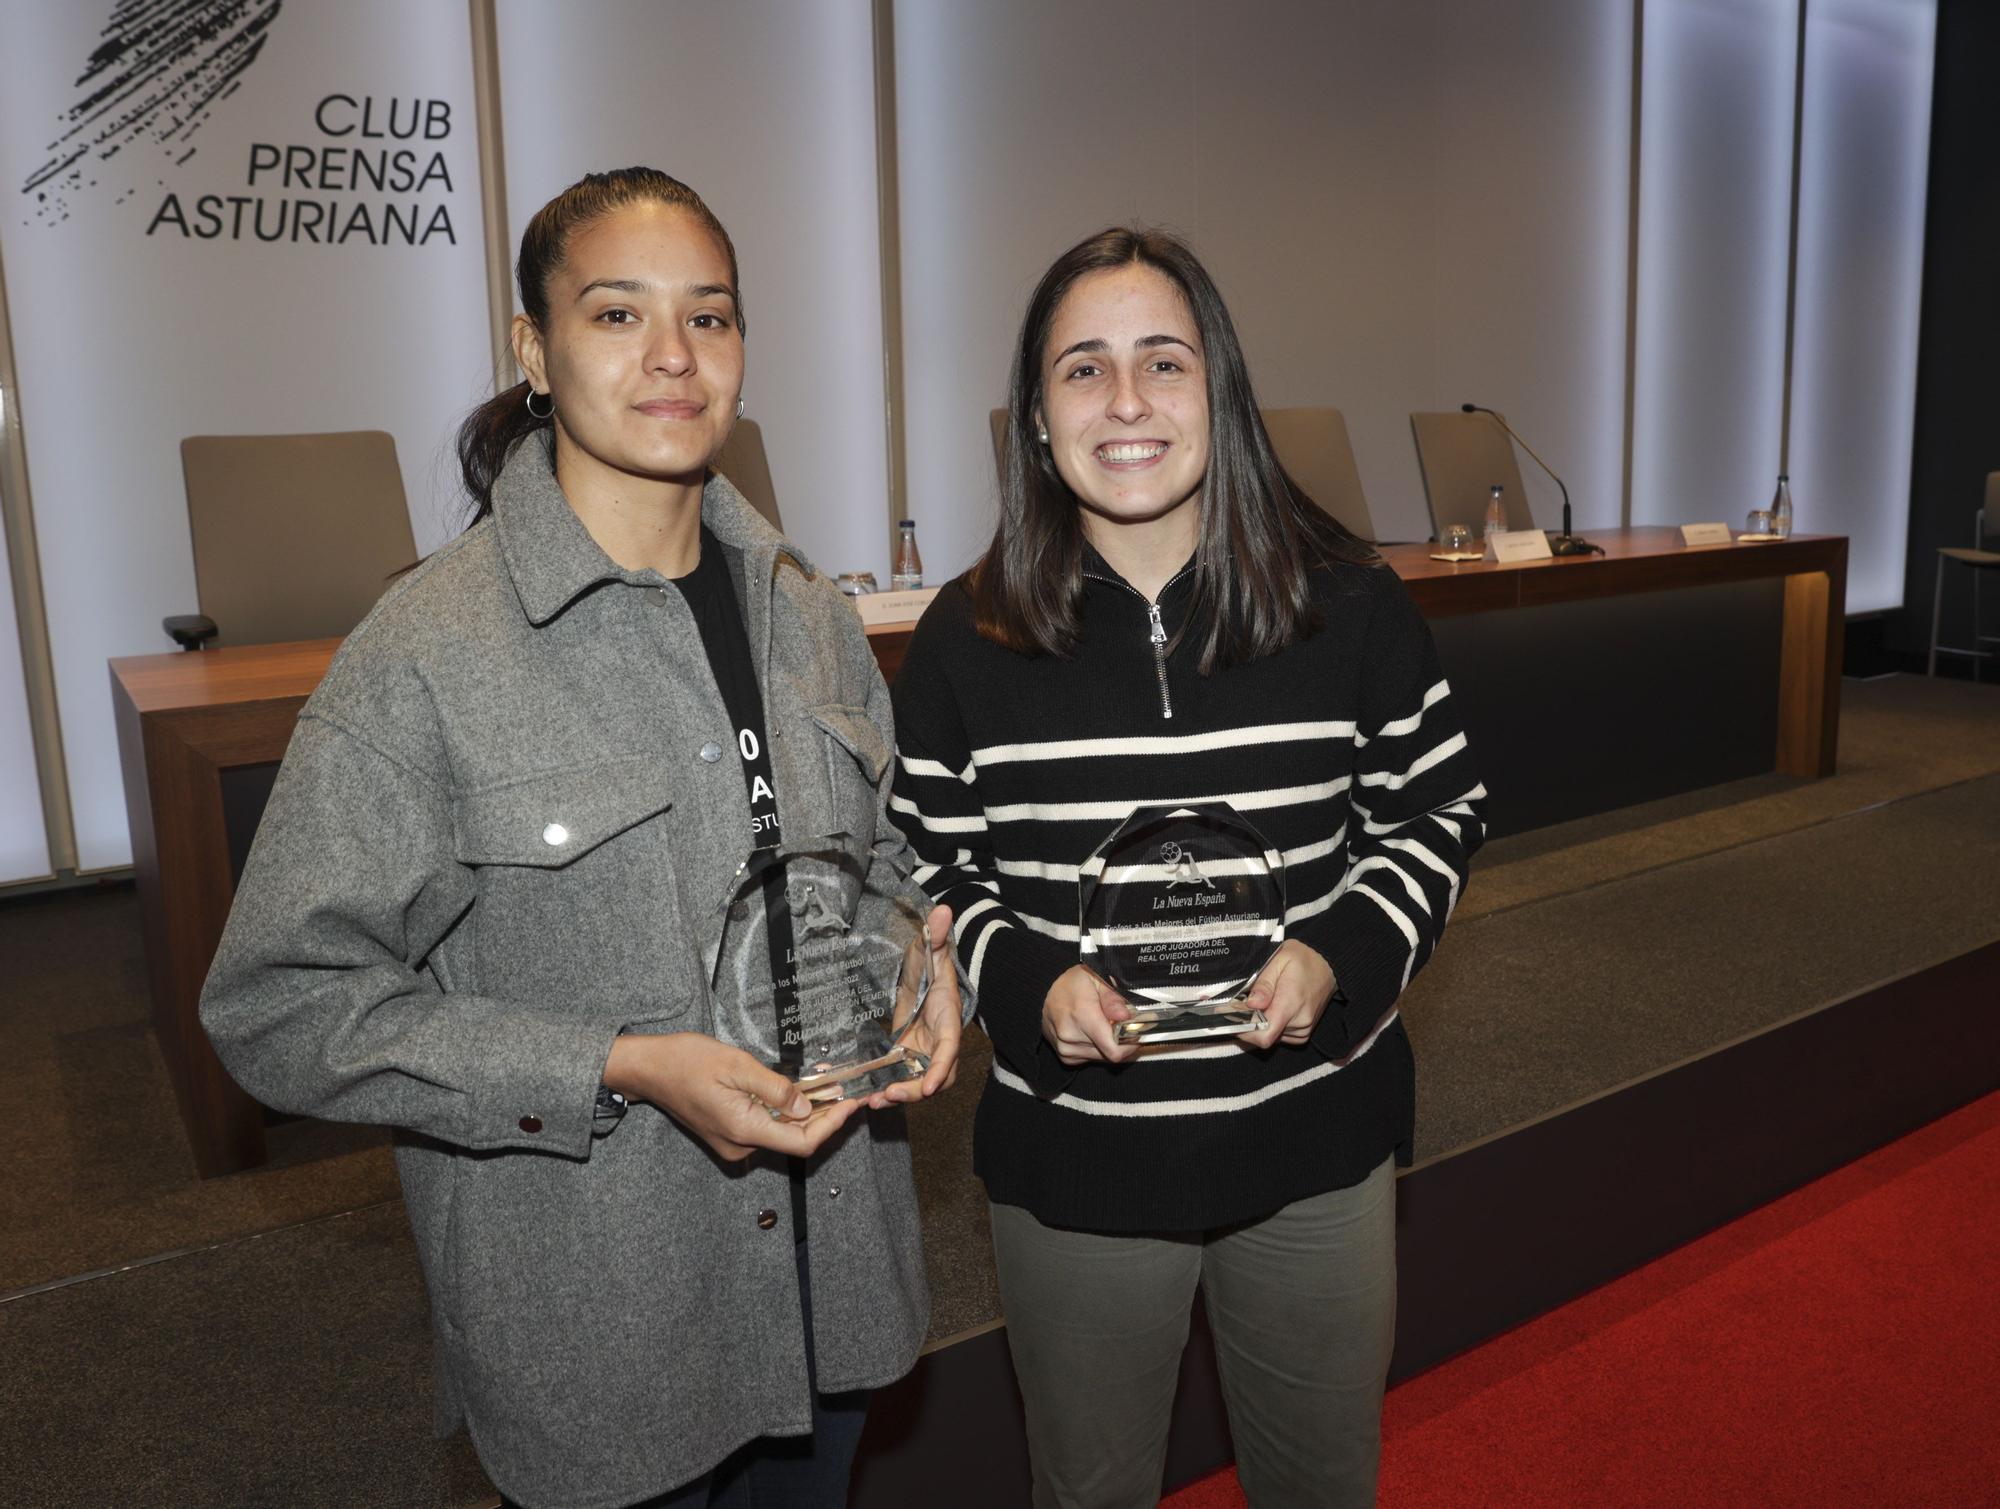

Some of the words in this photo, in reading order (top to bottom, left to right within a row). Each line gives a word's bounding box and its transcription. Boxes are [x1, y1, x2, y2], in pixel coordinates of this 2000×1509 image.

[315, 94, 452, 140] CLUB
[247, 143, 454, 193] PRENSA
[146, 193, 457, 245] ASTURIANA
[1153, 896, 1165, 910] La
[1166, 895, 1193, 909] Nueva
[1195, 891, 1226, 907] España
[1185, 916, 1197, 926] del
[1198, 913, 1222, 925] Fútbol
[1224, 911, 1260, 922] Asturiano
[1140, 944, 1167, 954] MEJOR
[1168, 940, 1210, 951] JUGADORA
[1211, 938, 1226, 947] DEL
[1137, 955, 1158, 963] REAL
[1159, 951, 1188, 961] OVIEDO
[1190, 947, 1230, 958] FEMENINO
[1168, 962, 1200, 975] Isina
[778, 978, 791, 989] los
